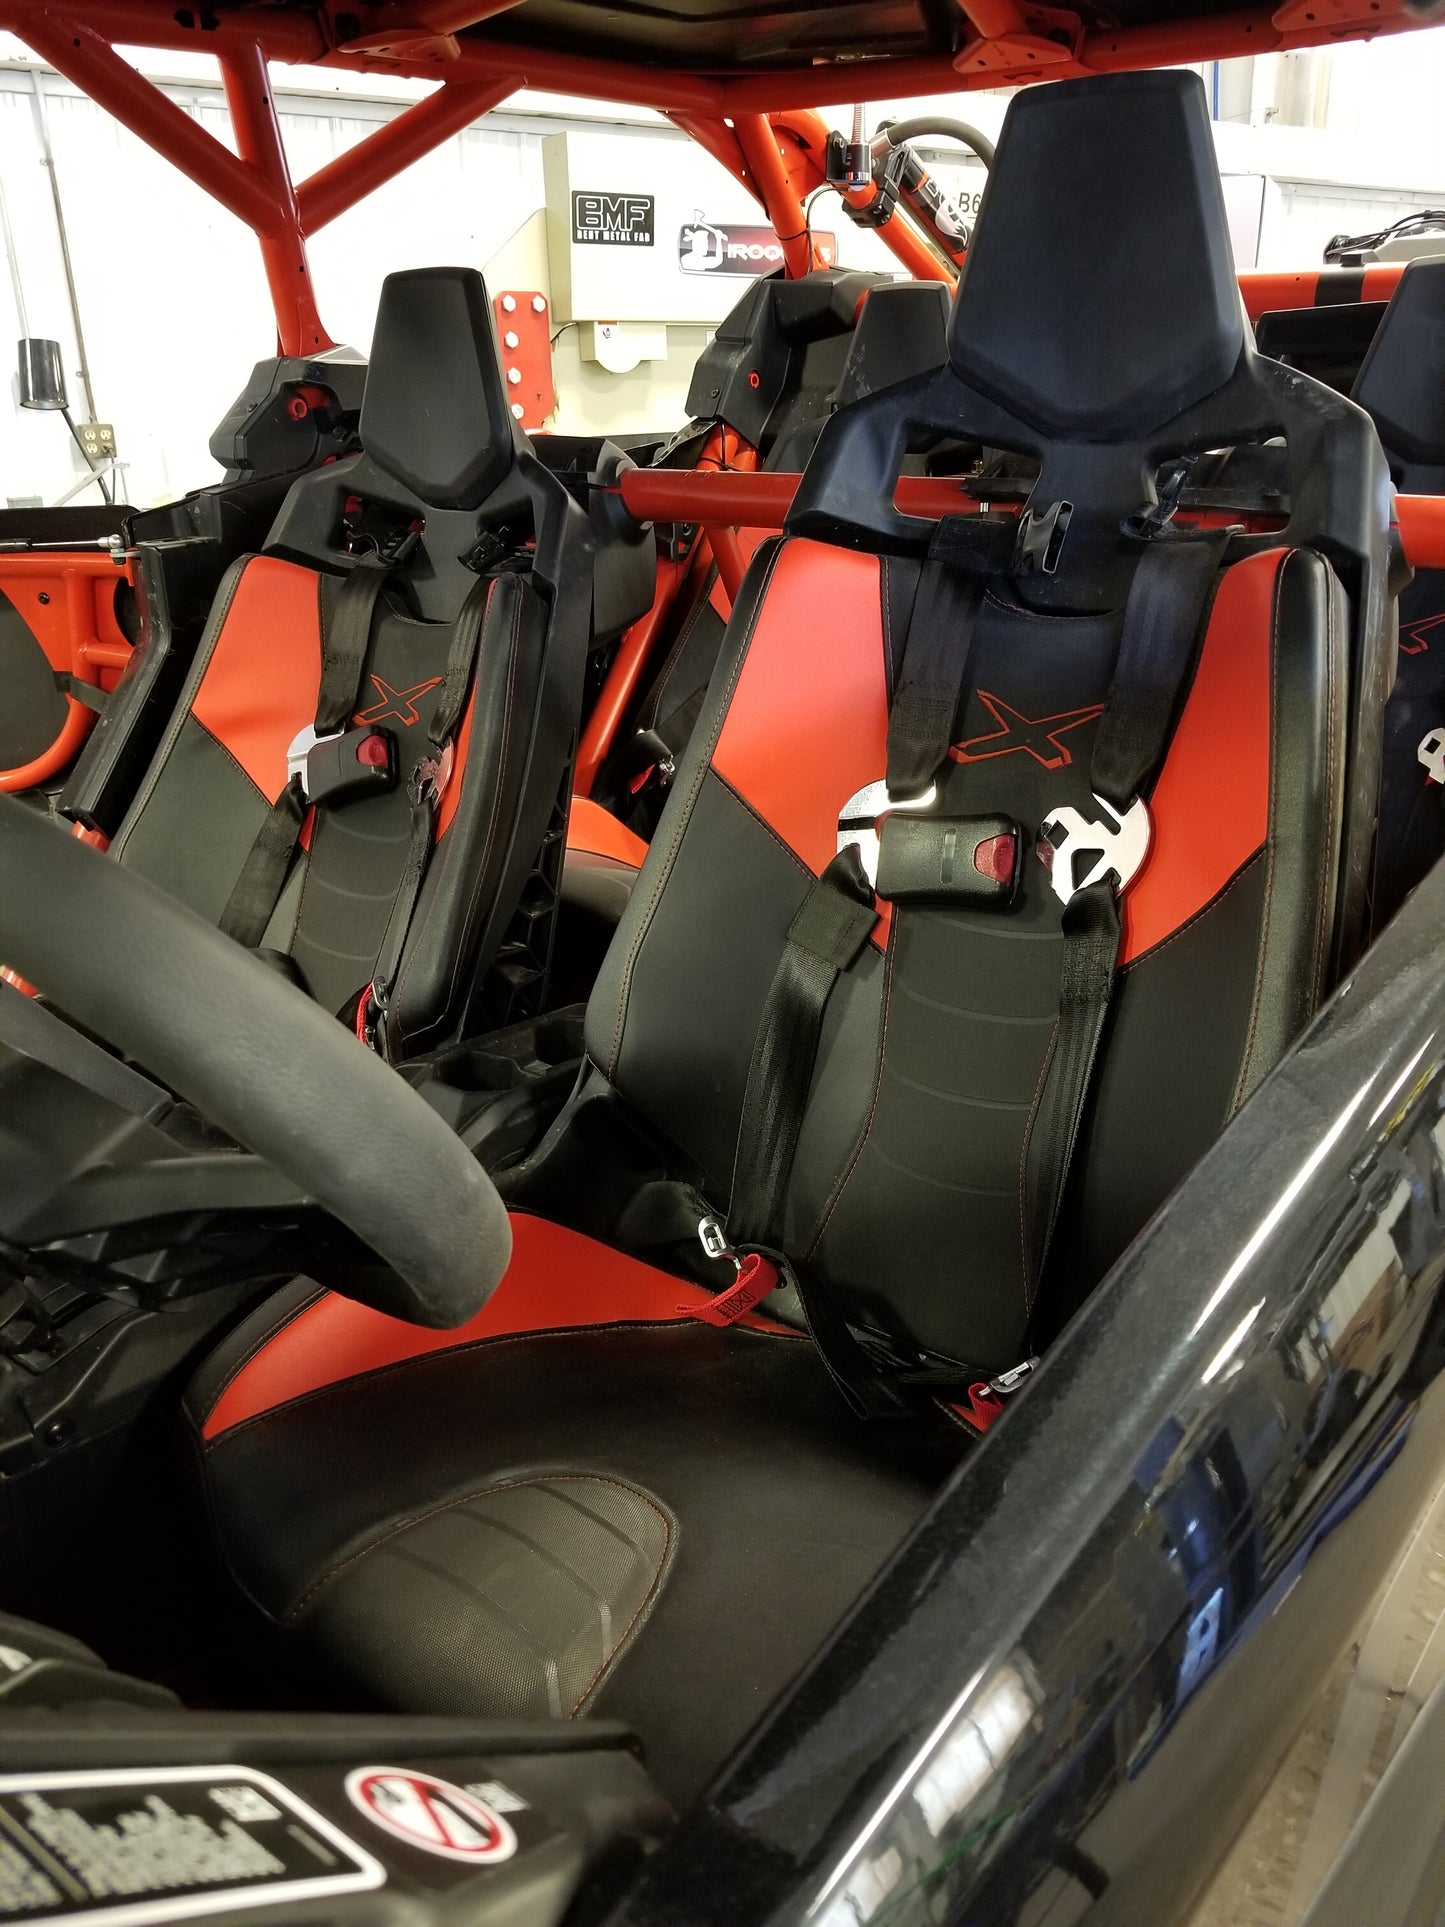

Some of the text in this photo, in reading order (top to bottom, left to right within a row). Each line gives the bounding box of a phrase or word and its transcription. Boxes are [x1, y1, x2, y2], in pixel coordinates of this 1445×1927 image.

[576, 195, 651, 231] BMF
[576, 230, 600, 240] BENT
[603, 231, 631, 241] METAL
